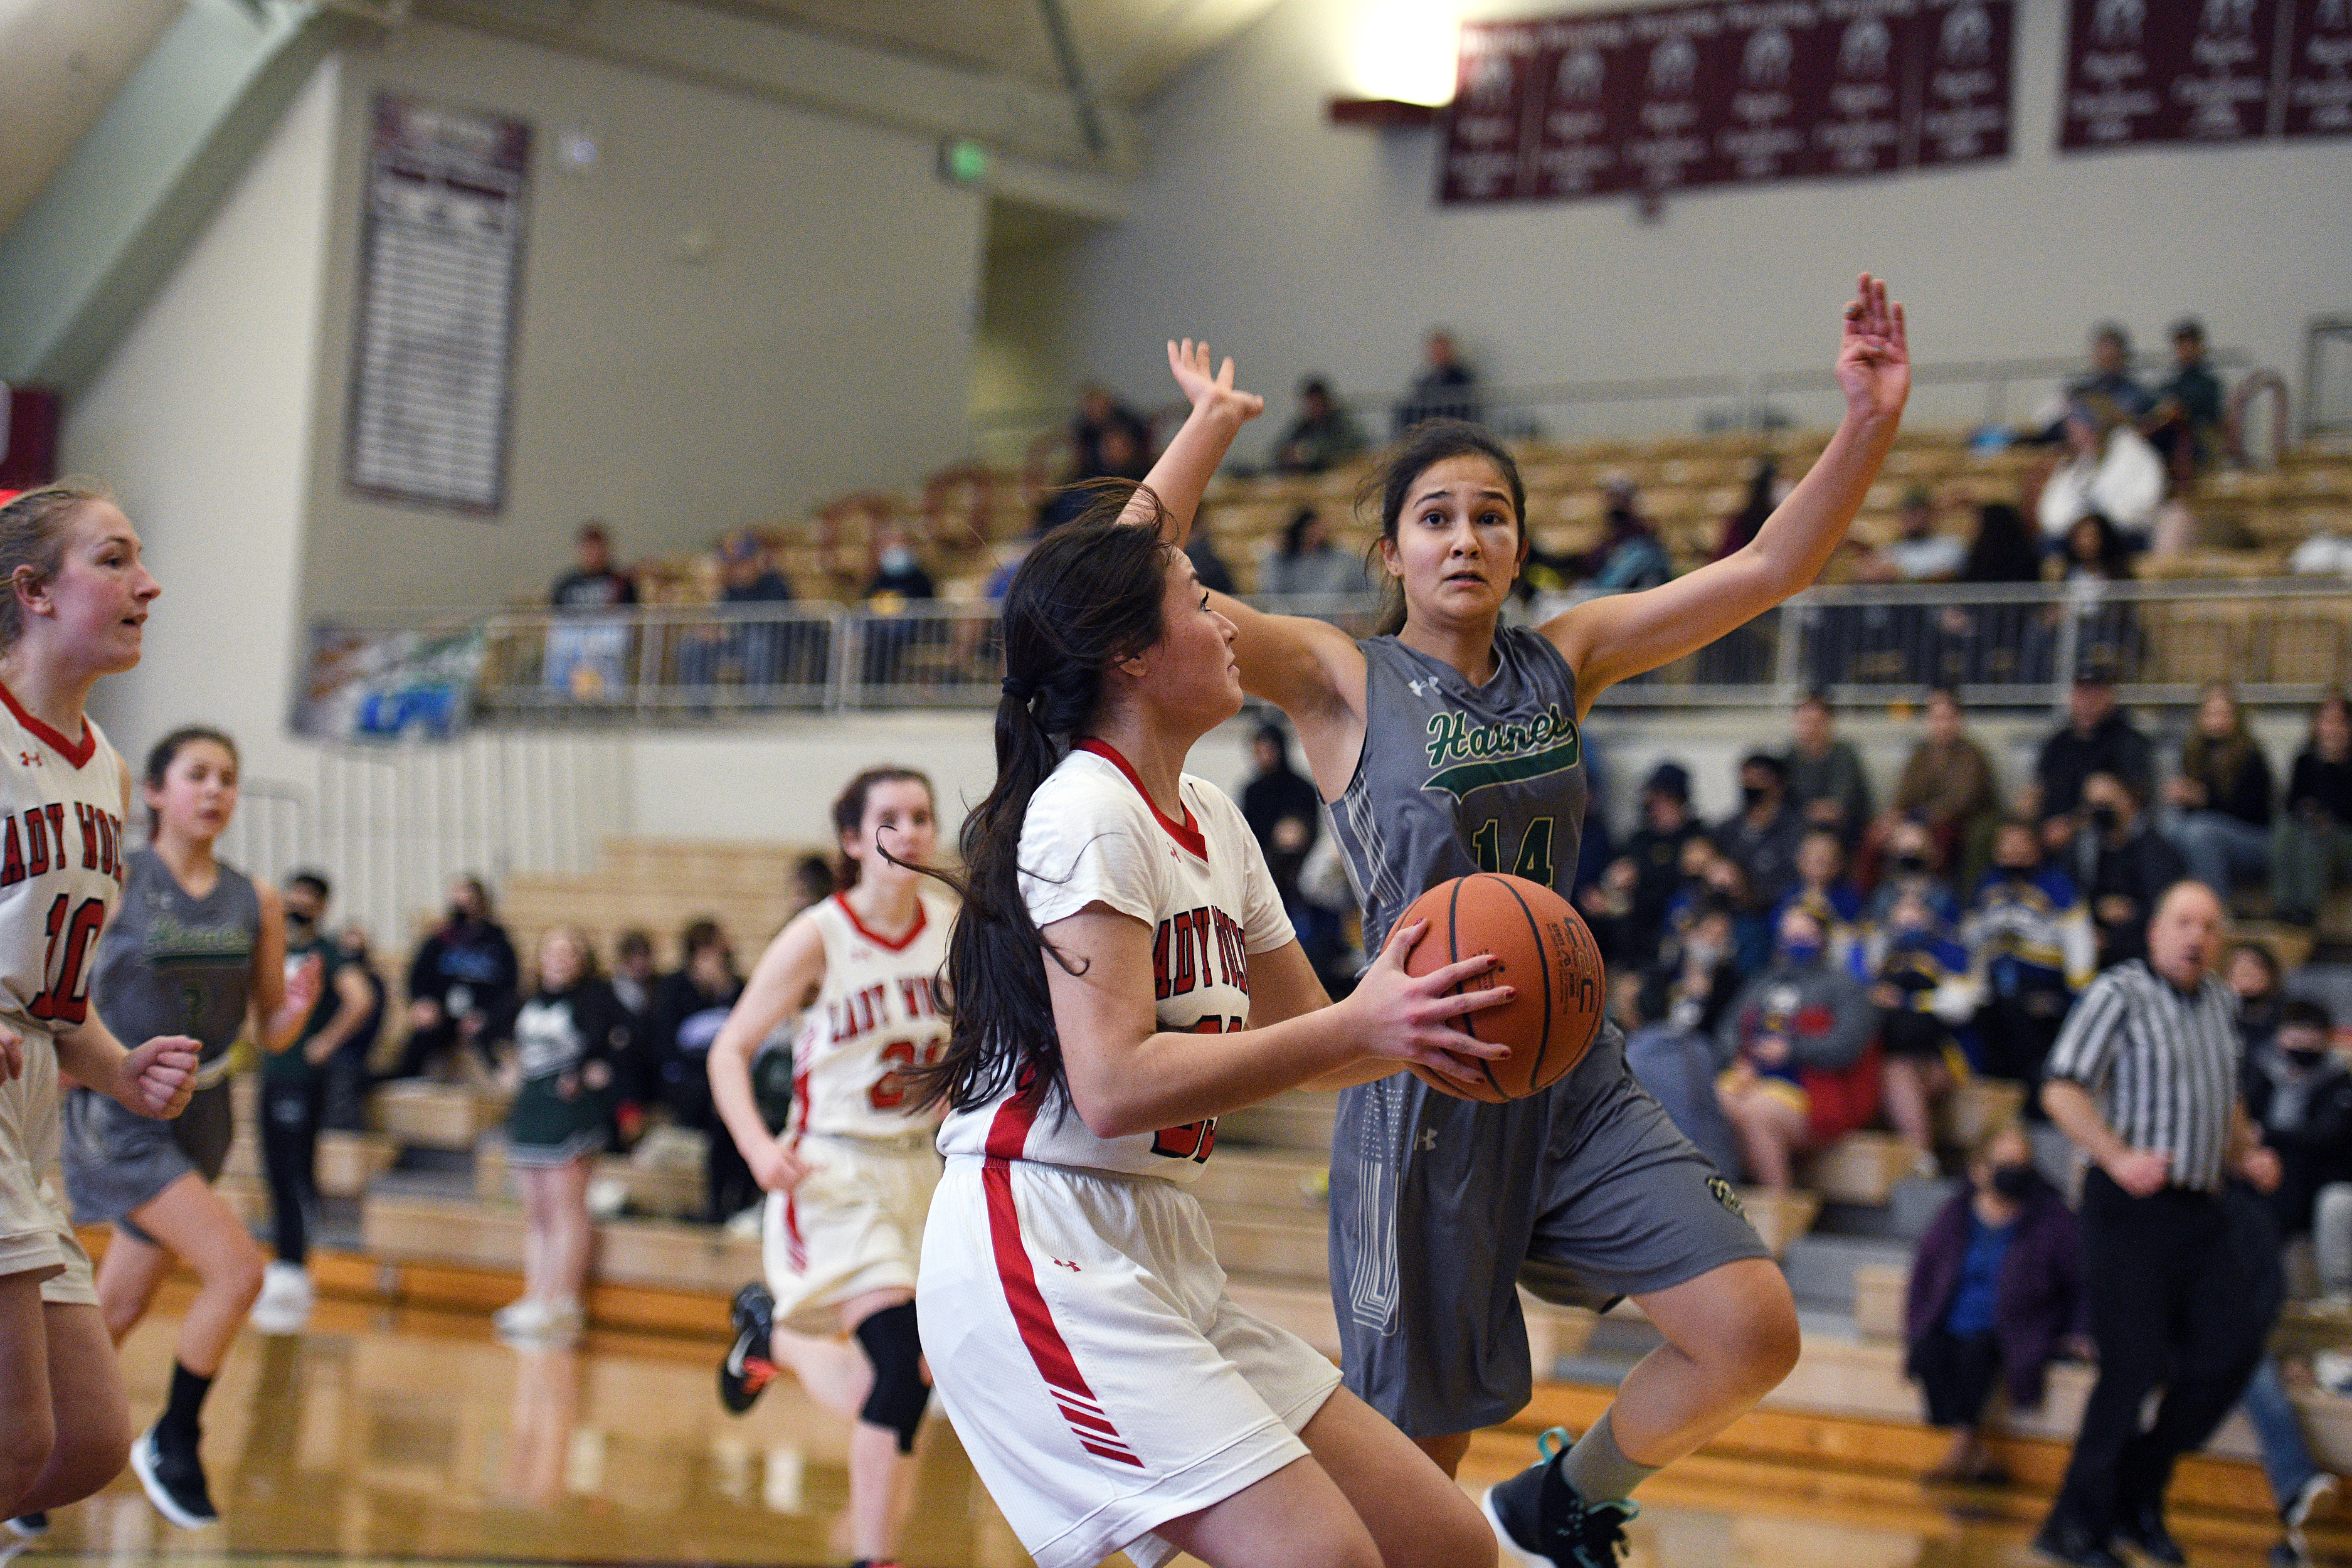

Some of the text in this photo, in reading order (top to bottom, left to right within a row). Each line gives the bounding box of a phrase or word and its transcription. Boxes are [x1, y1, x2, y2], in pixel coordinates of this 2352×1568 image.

[1426, 702, 1578, 769] Haines
[0, 800, 122, 887] ADY WOL
[1472, 817, 1554, 891] 14
[26, 893, 105, 1025] 10
[1153, 906, 1213, 1002] ADY
